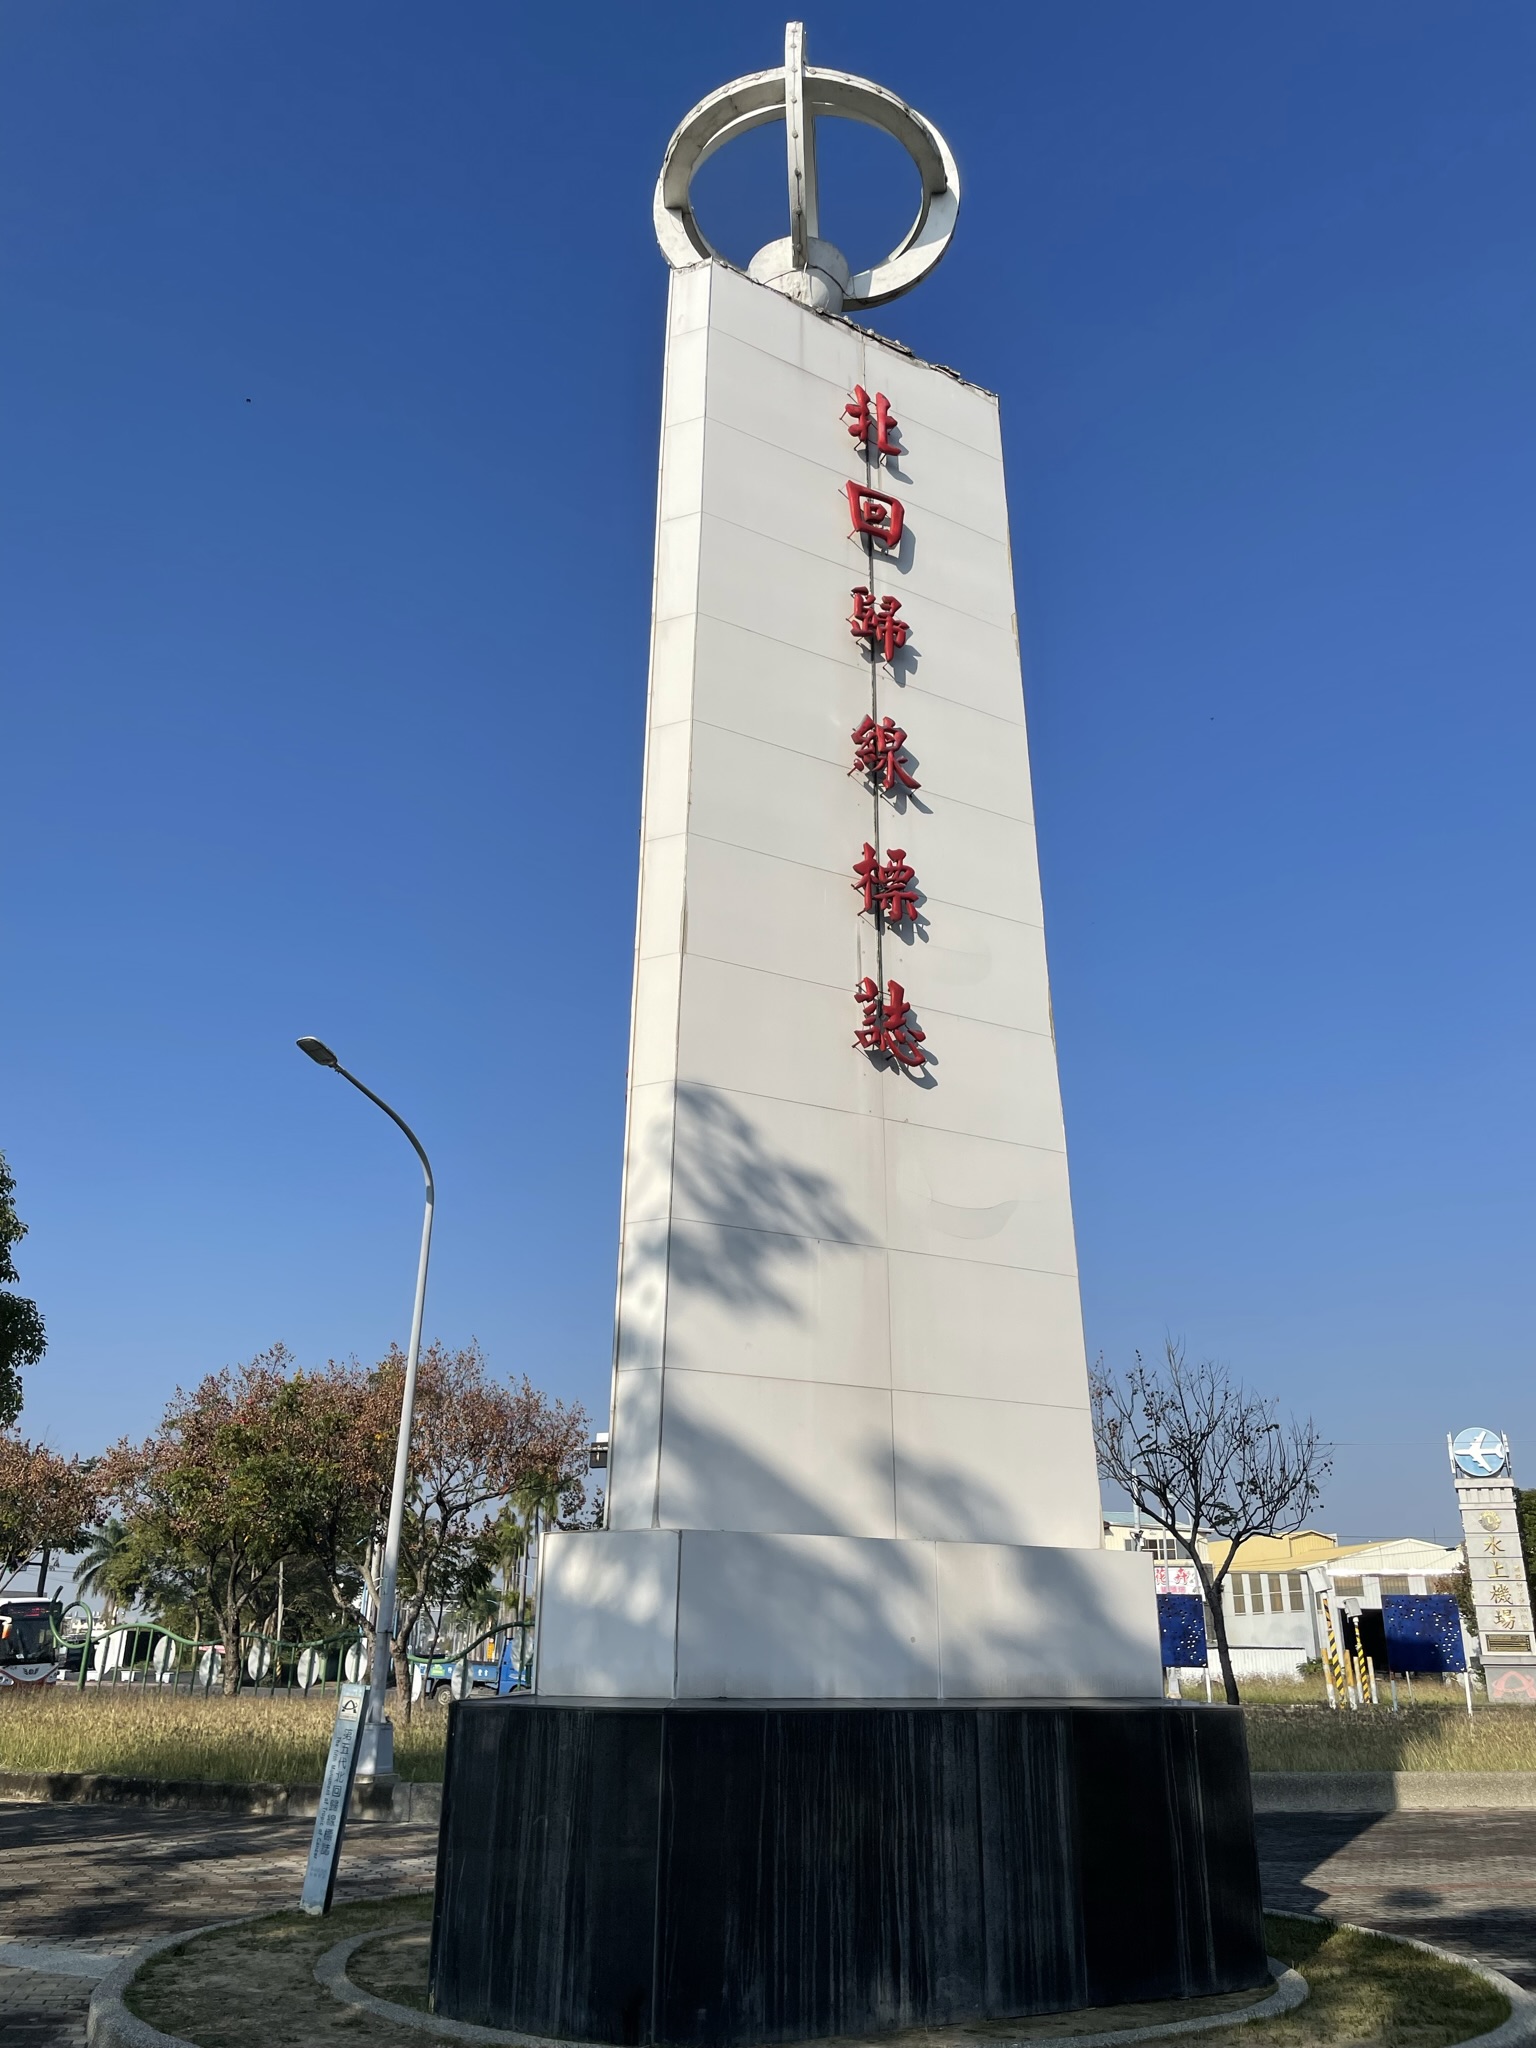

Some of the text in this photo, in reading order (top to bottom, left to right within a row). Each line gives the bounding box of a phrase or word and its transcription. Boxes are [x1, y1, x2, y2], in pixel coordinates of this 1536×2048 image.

[845, 384, 926, 1067] 北回歸線標誌
[1483, 1534, 1516, 1630] 水上機場
